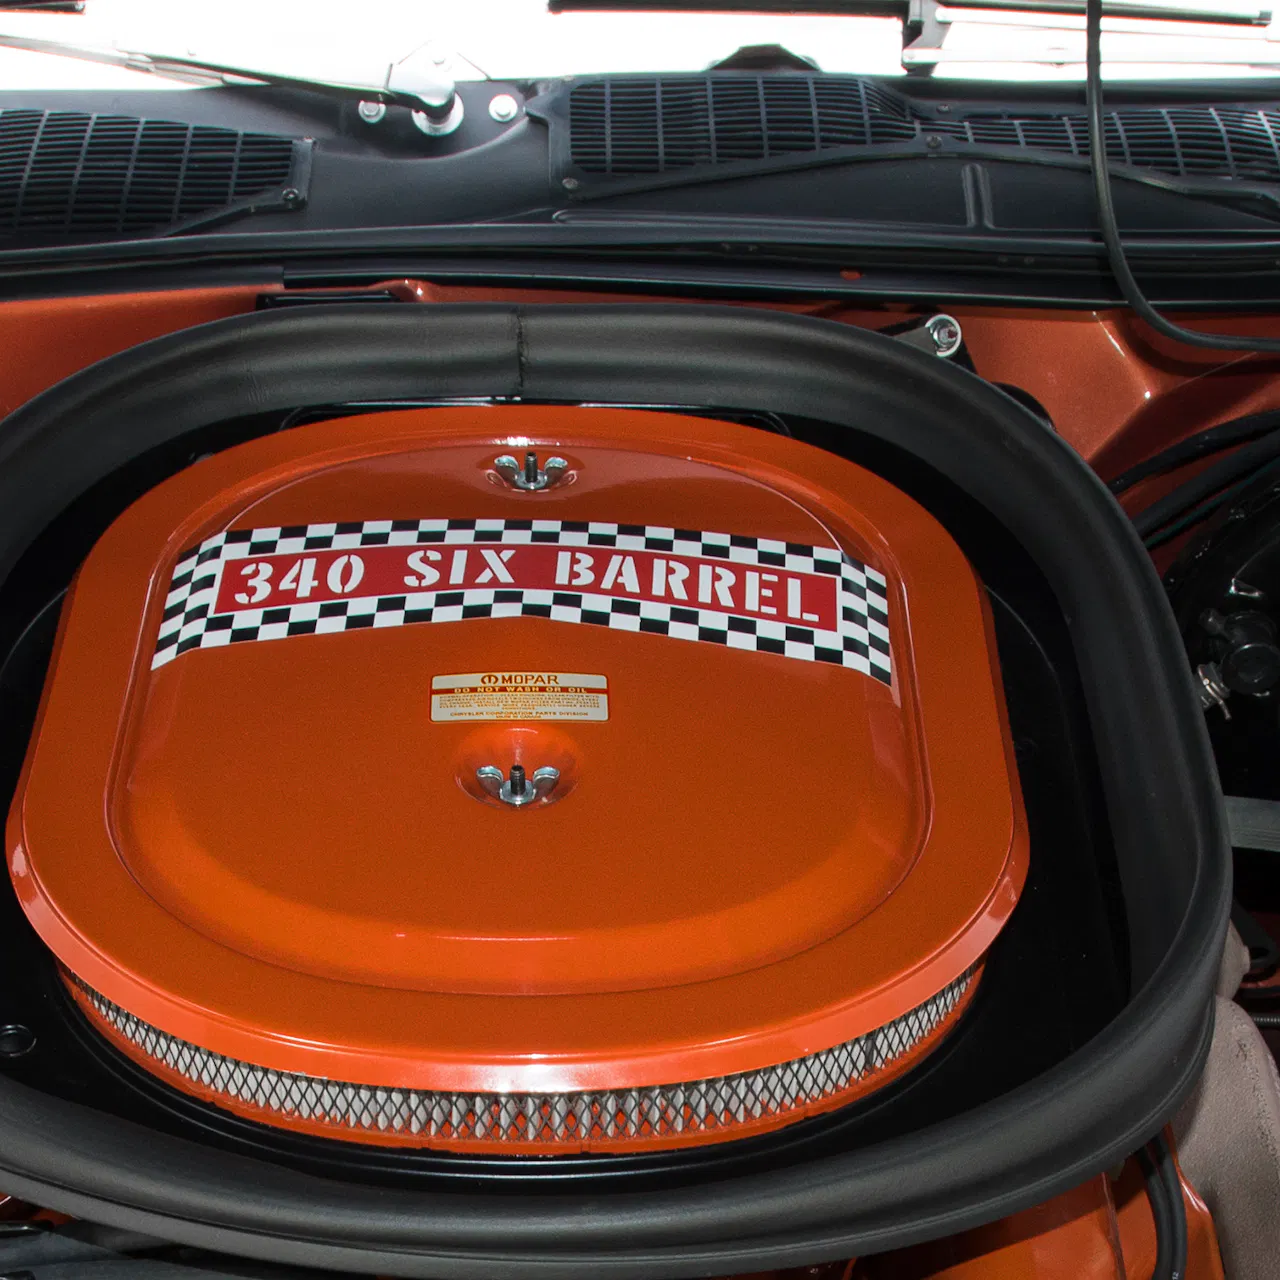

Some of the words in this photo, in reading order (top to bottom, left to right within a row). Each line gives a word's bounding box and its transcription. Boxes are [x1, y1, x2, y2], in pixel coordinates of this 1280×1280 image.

[233, 553, 365, 605] 340
[404, 547, 520, 587] SIX
[555, 552, 820, 623] BARREL
[501, 675, 559, 685] MOPAR
